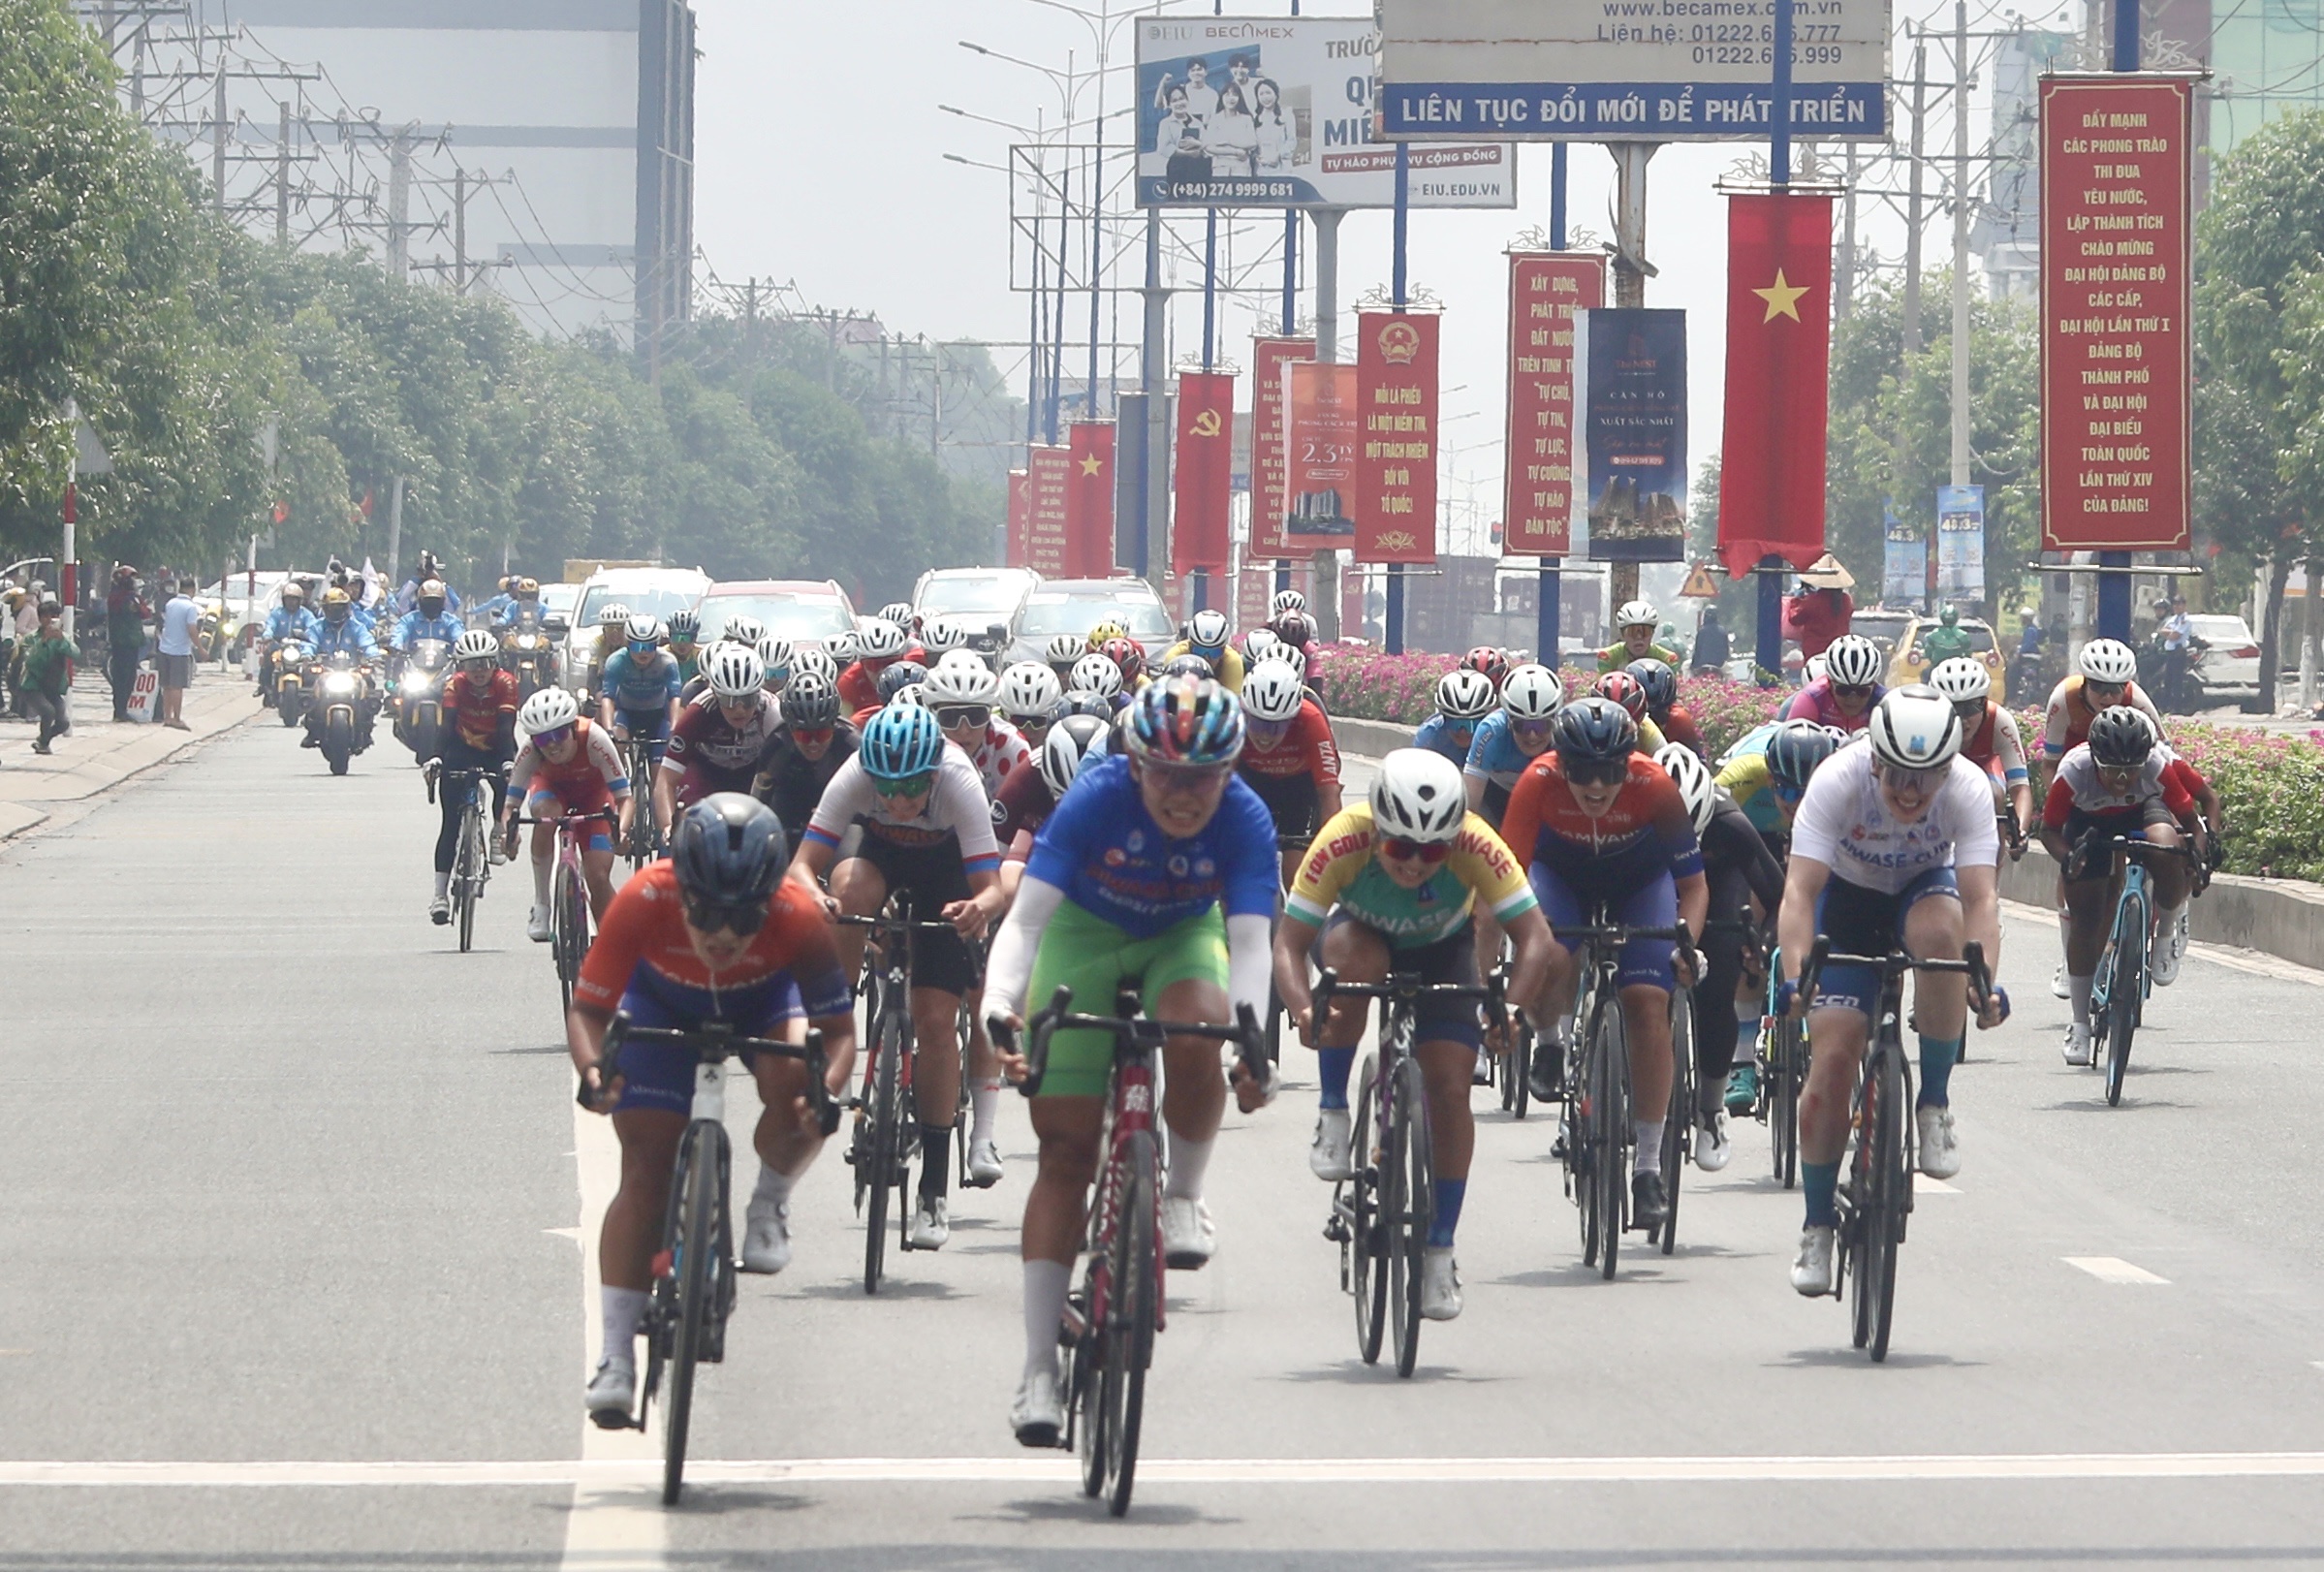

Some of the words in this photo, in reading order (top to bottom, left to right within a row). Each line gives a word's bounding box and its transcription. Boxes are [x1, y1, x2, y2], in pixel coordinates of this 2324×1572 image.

[1604, 0, 1842, 16] www.becamex.cm.vn
[1597, 24, 1643, 45] Liên
[1650, 24, 1683, 46] hệ:
[1402, 93, 1461, 121] LIÊN
[1475, 99, 1527, 128] TỤC
[1540, 86, 1586, 122] ĐỔI
[1597, 91, 1646, 122] MỚI
[1658, 86, 1693, 122] ĐỂ
[1705, 90, 1773, 122] PHÁT
[1789, 86, 1865, 122] TRIỂN
[2083, 109, 2107, 127] ĐẨY
[2110, 113, 2147, 130] MẠNH
[2063, 137, 2088, 153] CÁC
[2090, 139, 2132, 153] PHONG
[2136, 136, 2167, 152] TRÀO
[1326, 157, 1343, 170] TỰ
[1344, 155, 1369, 168] HÀO
[1372, 155, 1397, 168] PHỤ
[1408, 154, 1424, 167] VỤ
[1426, 151, 1460, 166] CỘNG
[2093, 165, 2113, 178] THI
[2116, 165, 2141, 178] ĐUA
[1173, 181, 1207, 199] (+84)
[1209, 181, 1234, 197] 274
[1236, 181, 1268, 197] 9999
[1270, 181, 1294, 197] 681
[1423, 183, 1500, 197] EIU.EDU.VN
[2084, 188, 2107, 204] YÊU
[2067, 214, 2090, 234] LẬP
[2093, 213, 2134, 230] THÀNH
[2137, 213, 2163, 229] TÍCH
[2081, 239, 2114, 256] CHÀO
[2065, 267, 2085, 285] ĐẠI
[2088, 265, 2109, 284] HỘI
[2113, 263, 2146, 281] ĐẢNG
[2149, 264, 2166, 284] BỘ
[2088, 290, 2114, 306] CÁC
[2117, 288, 2143, 308] CẤP,
[2060, 319, 2081, 336] ĐẠI
[2084, 316, 2104, 336] HỘI
[2161, 318, 2170, 331] I
[2088, 340, 2121, 359] ĐẢNG
[2125, 341, 2143, 361] BỘ
[2081, 367, 2121, 384] THÀNH
[2124, 365, 2150, 384] PHỐ
[2084, 393, 2099, 410] VÀ
[2103, 396, 2123, 413] ĐẠI
[2126, 393, 2147, 412] HỘI
[2089, 422, 2110, 438] ĐẠI
[1303, 443, 1336, 463] 2.3
[2081, 444, 2114, 461] TOÀN
[2118, 442, 2150, 461] QUỐC
[2133, 473, 2152, 487] XIV
[2084, 494, 2108, 513] CỦA
[1317, 740, 1337, 775] ANTA
[1329, 831, 1370, 859] GOLD
[1457, 830, 1514, 880] IWASE
